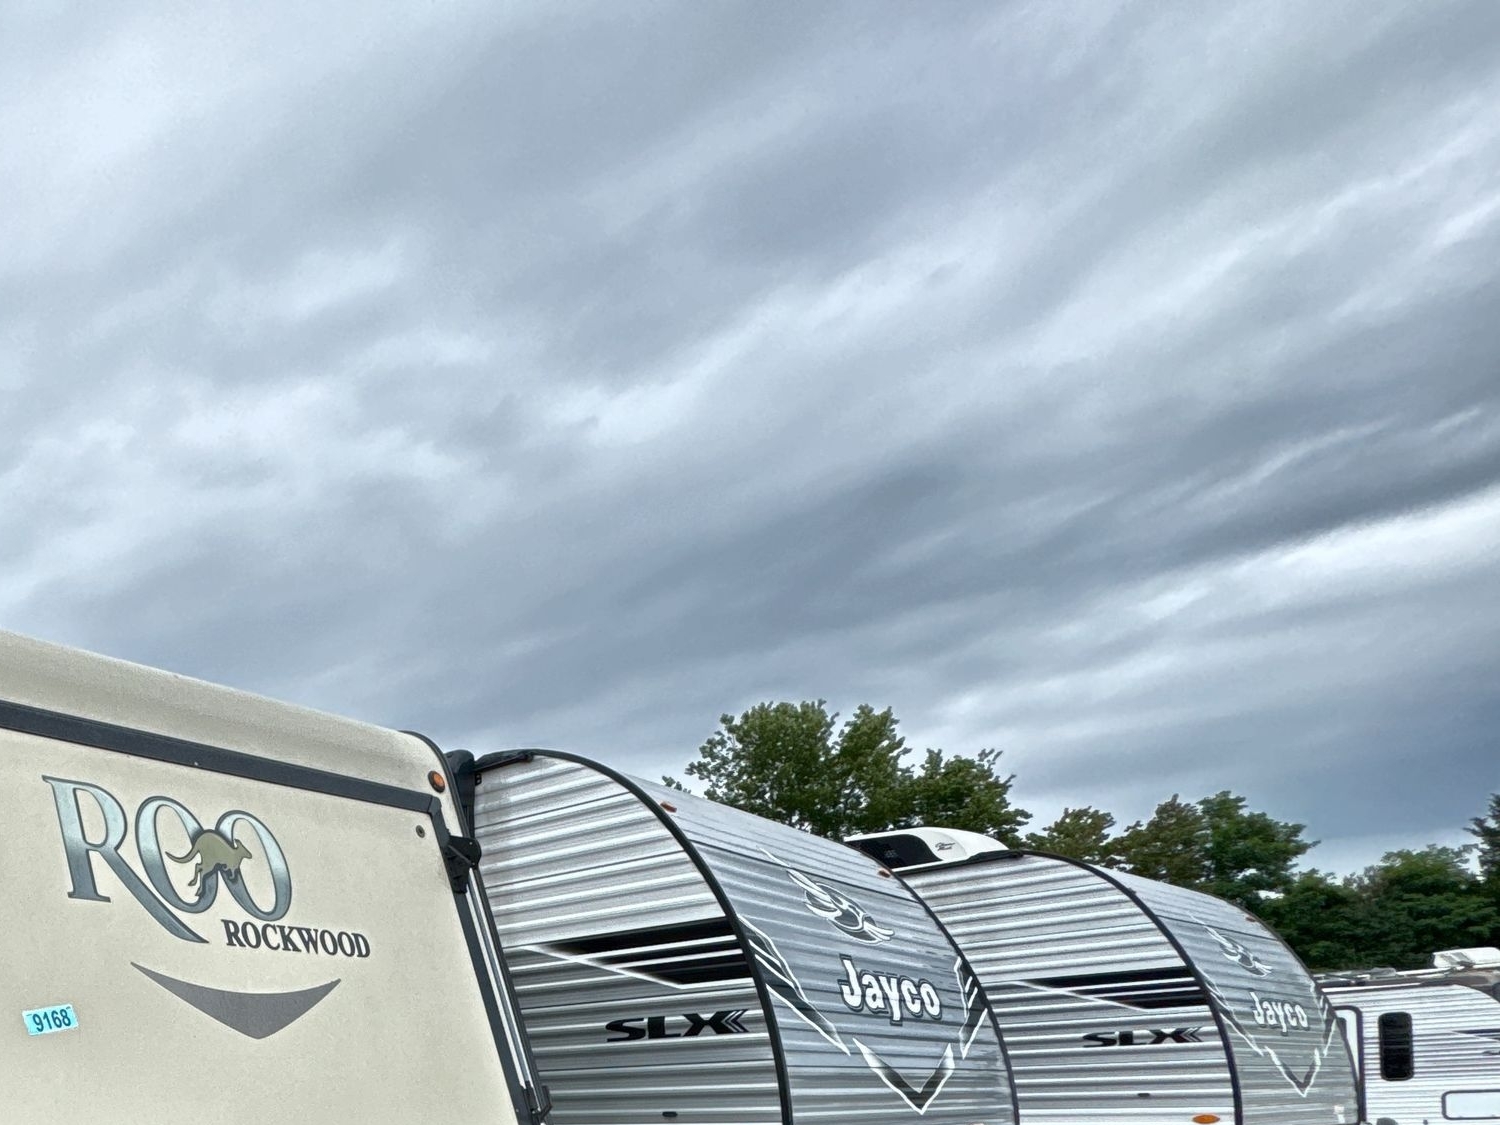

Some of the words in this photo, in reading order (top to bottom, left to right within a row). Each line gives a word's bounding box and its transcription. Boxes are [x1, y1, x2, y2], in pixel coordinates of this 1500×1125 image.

[41, 775, 292, 944] ROO
[221, 919, 371, 958] ROCKWOOD
[837, 954, 944, 1026] Jayco
[32, 1009, 71, 1032] 9168
[1249, 991, 1310, 1036] Jayco
